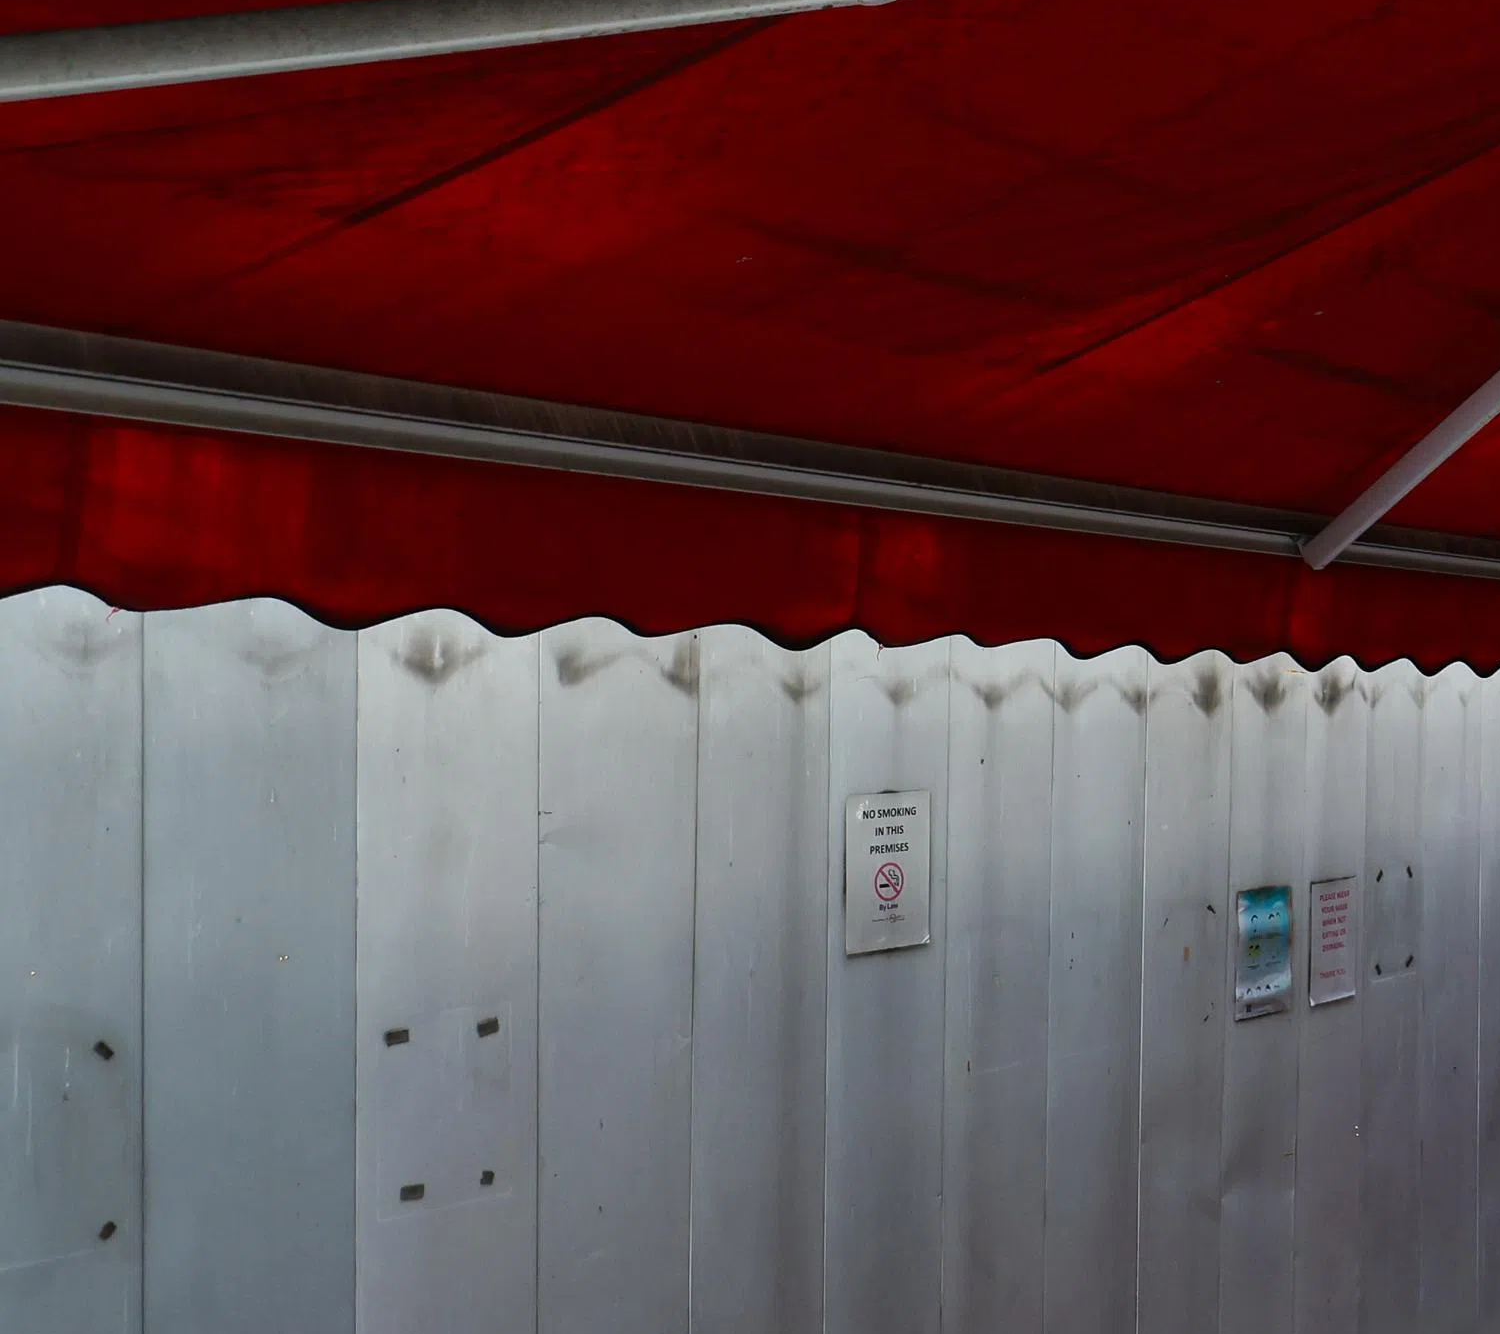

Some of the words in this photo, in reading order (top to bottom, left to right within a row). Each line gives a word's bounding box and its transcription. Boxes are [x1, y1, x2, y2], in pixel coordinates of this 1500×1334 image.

[862, 809, 876, 820] NO
[877, 806, 917, 819] SMOKING
[875, 827, 885, 837] IN
[886, 825, 904, 835] THIS
[869, 842, 909, 855] PREMISES
